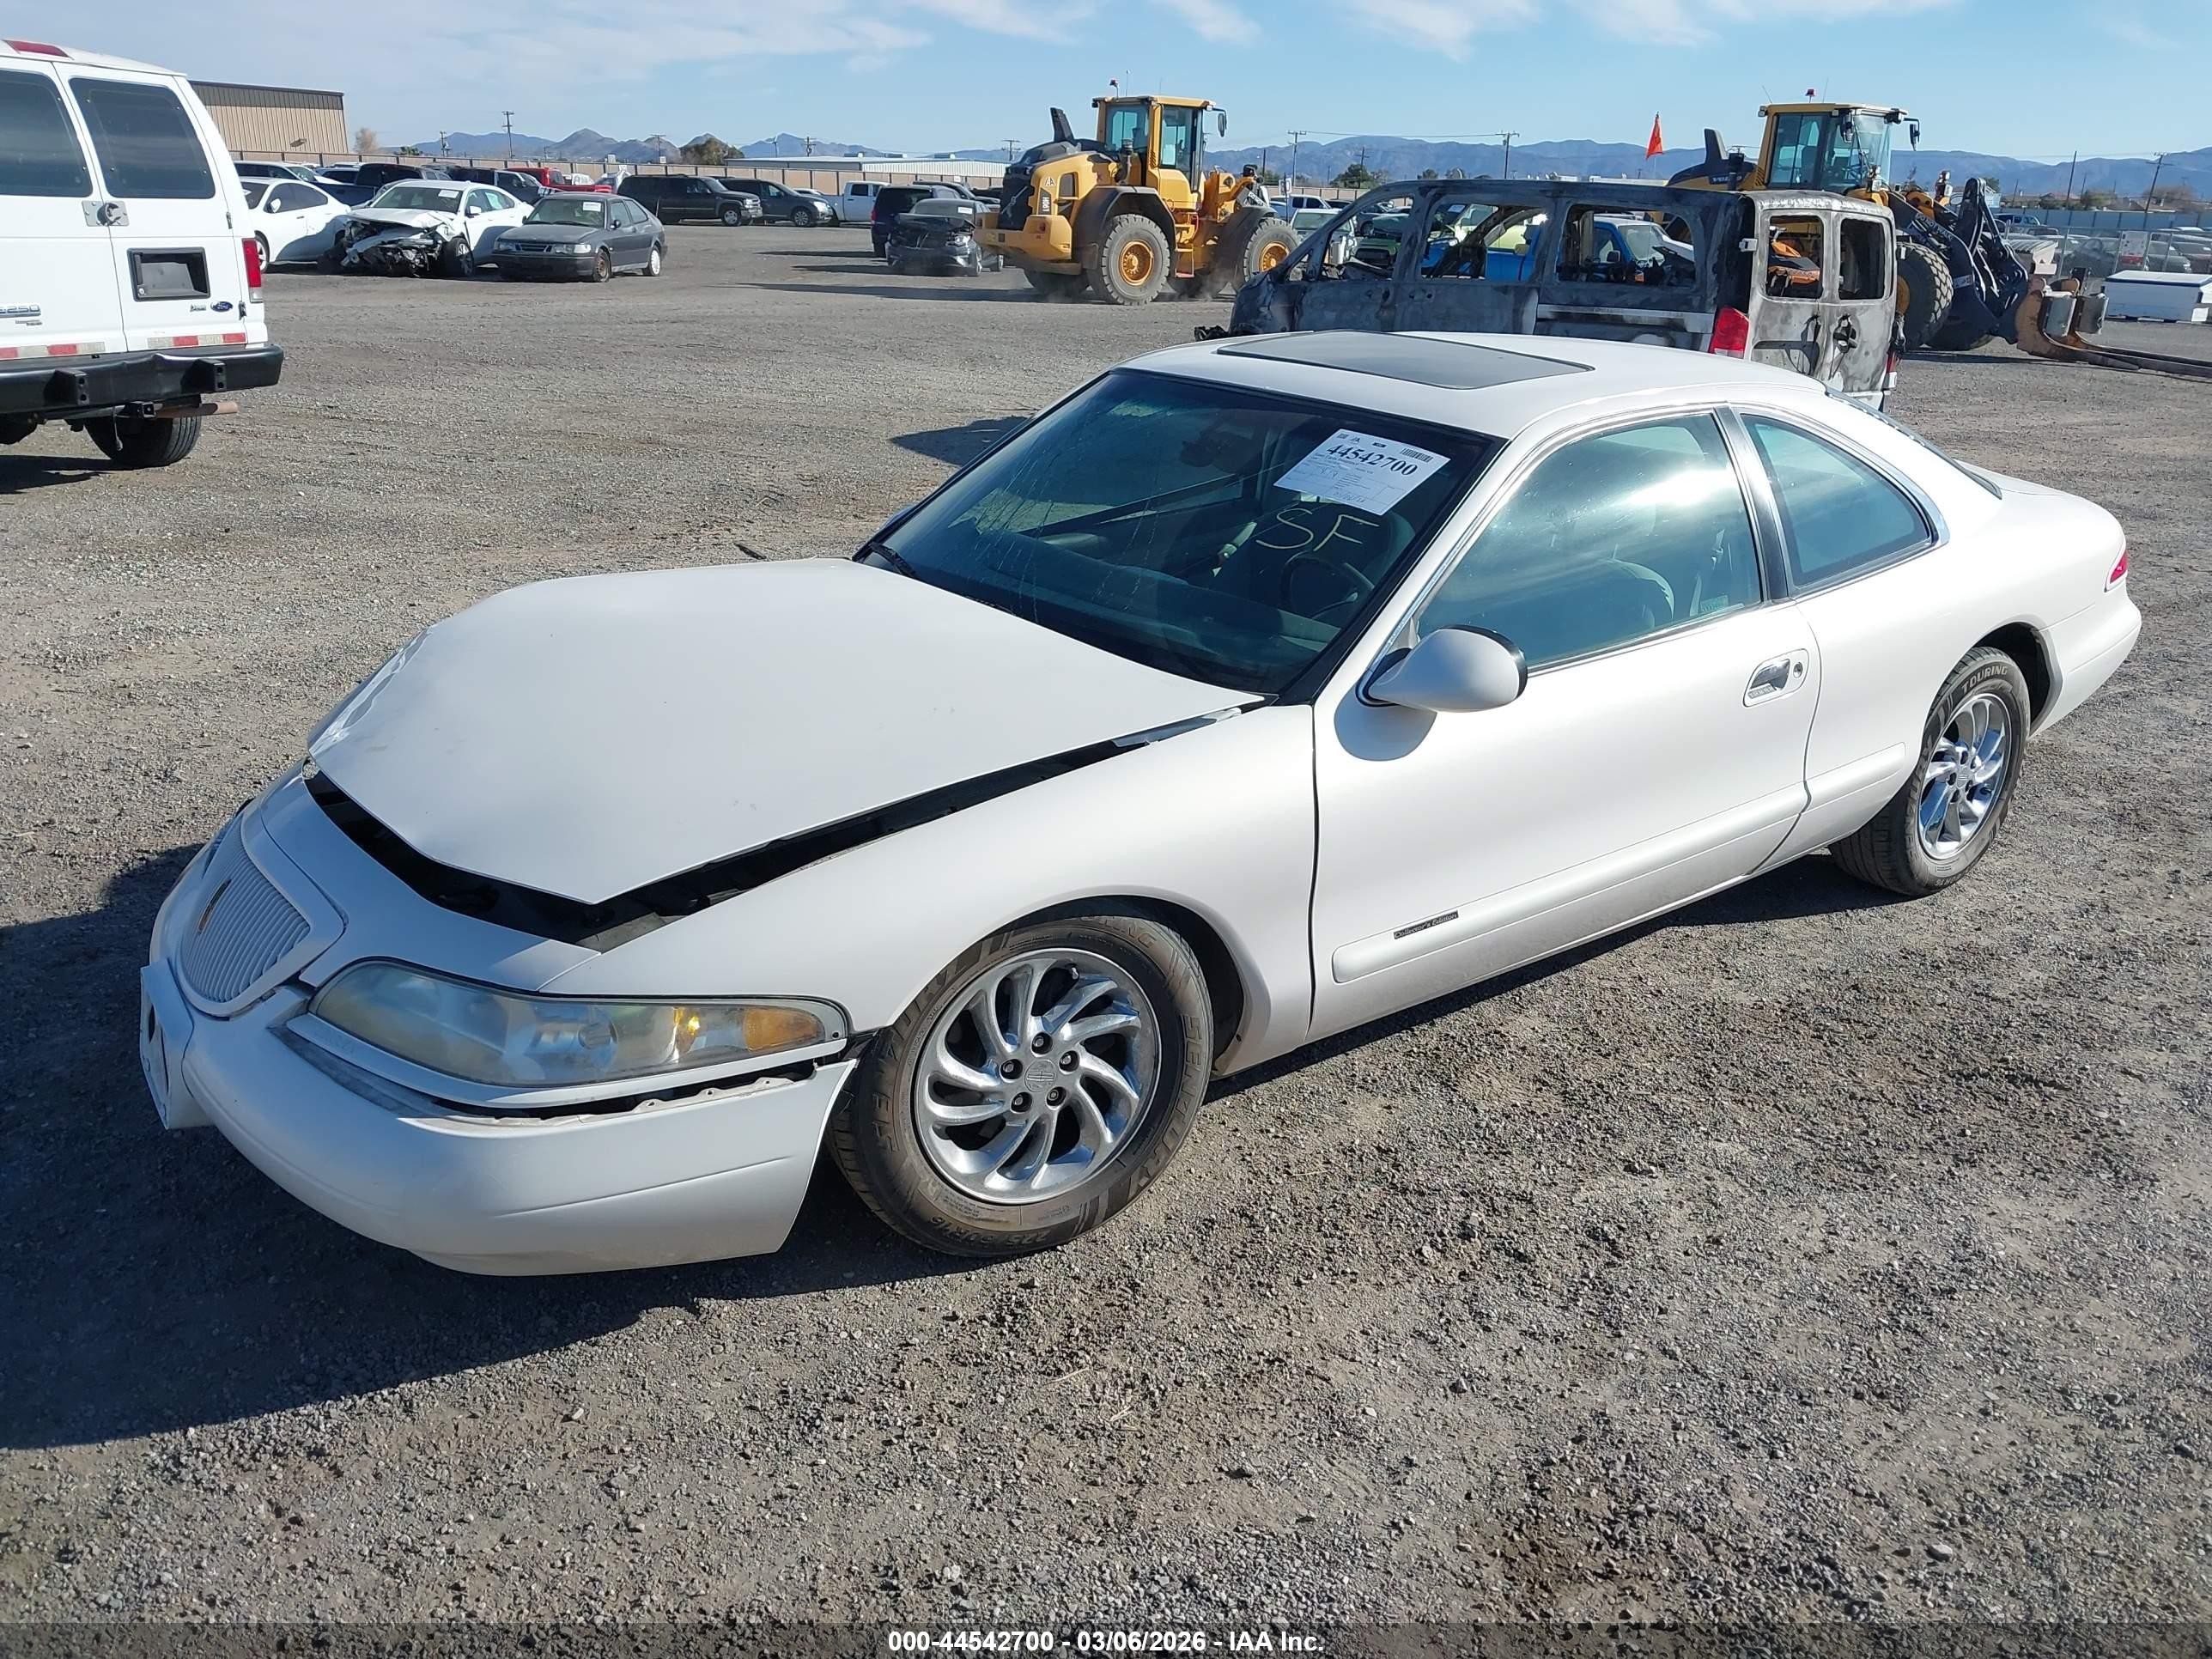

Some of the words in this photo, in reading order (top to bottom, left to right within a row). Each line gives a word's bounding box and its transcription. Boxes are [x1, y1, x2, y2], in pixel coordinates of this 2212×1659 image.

[1327, 444, 1418, 476] 44542700
[1255, 507, 1380, 552] SF
[1961, 665, 2008, 691] TOURING
